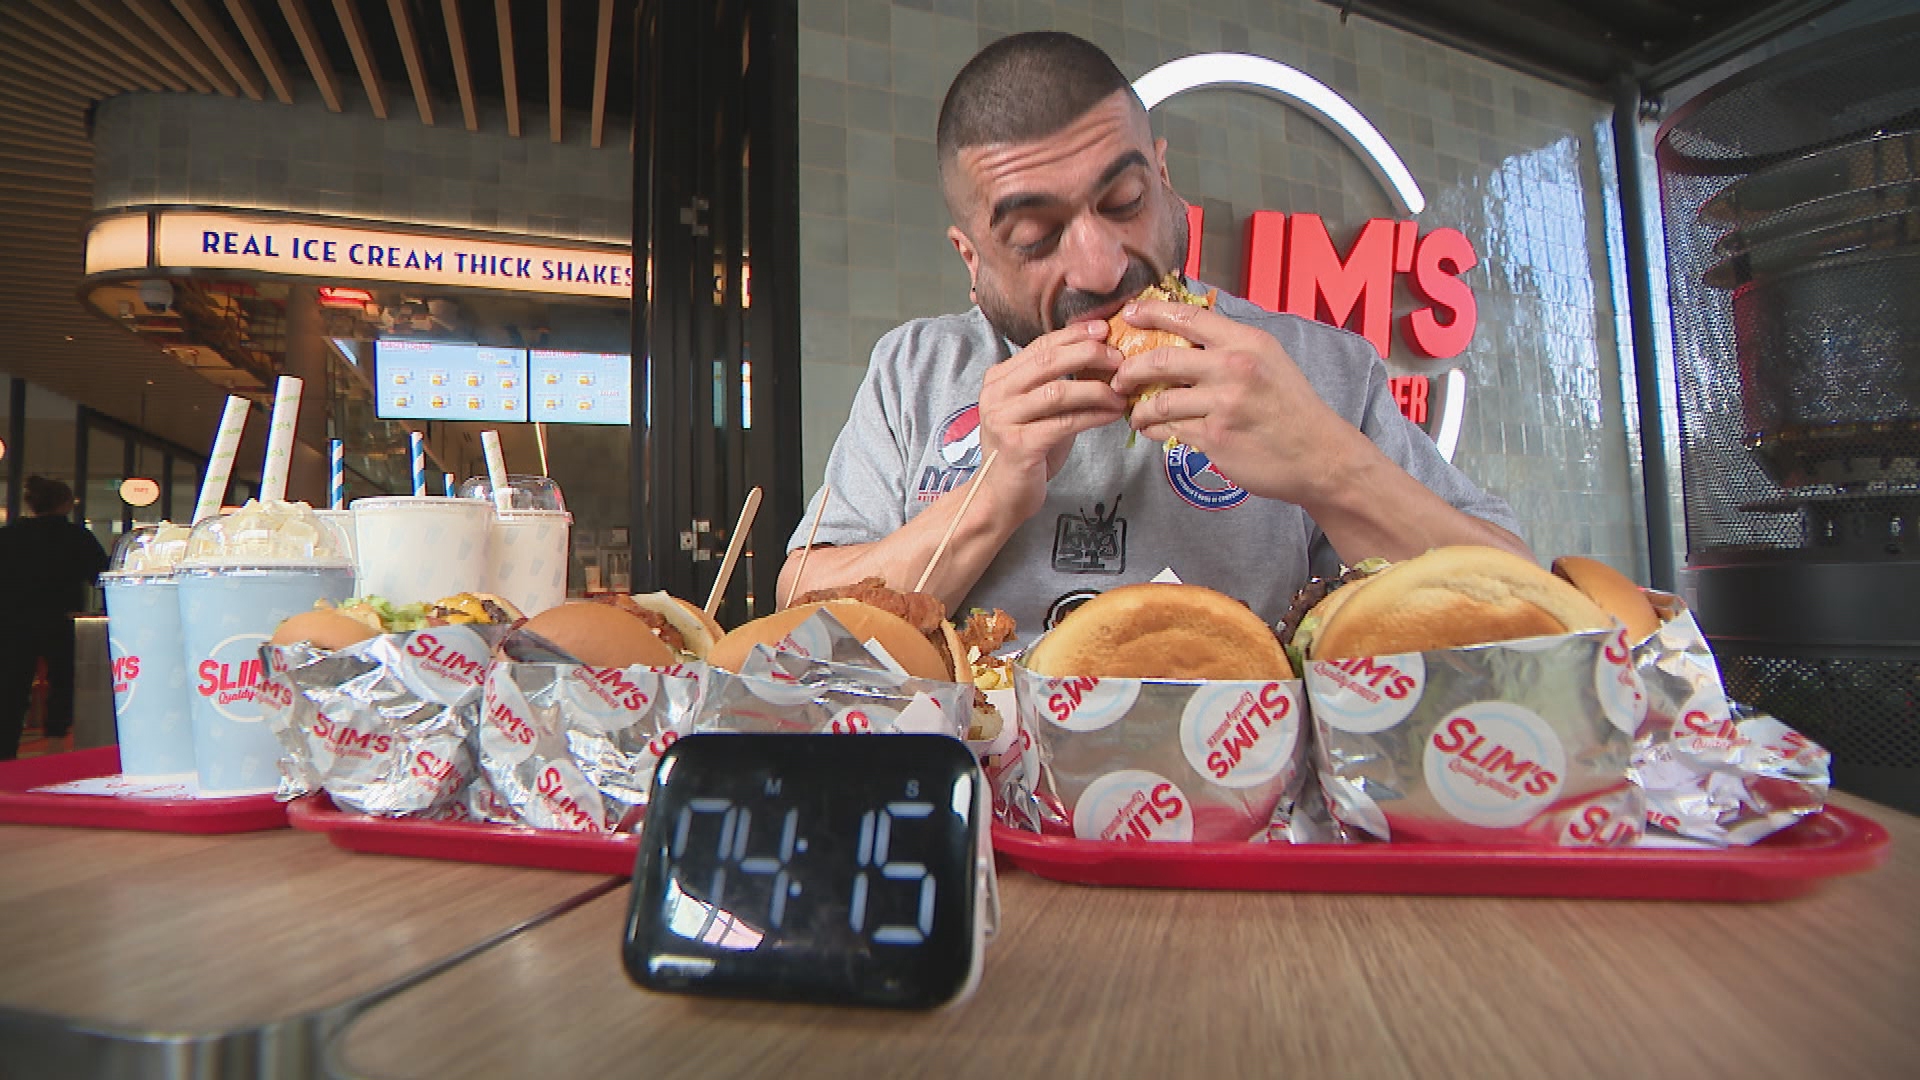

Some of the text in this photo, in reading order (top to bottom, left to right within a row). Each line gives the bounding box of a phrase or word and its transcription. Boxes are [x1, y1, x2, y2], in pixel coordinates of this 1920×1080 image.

[202, 231, 632, 287] REAL ICE CREAM THICK SHAKES
[407, 634, 485, 686] SLIM'S
[1324, 656, 1416, 701] IM'S
[582, 663, 649, 711] IM'S
[313, 711, 392, 753] SLIM'S
[1207, 682, 1291, 779] SLIM'S
[1433, 717, 1558, 797] SLIM'S
